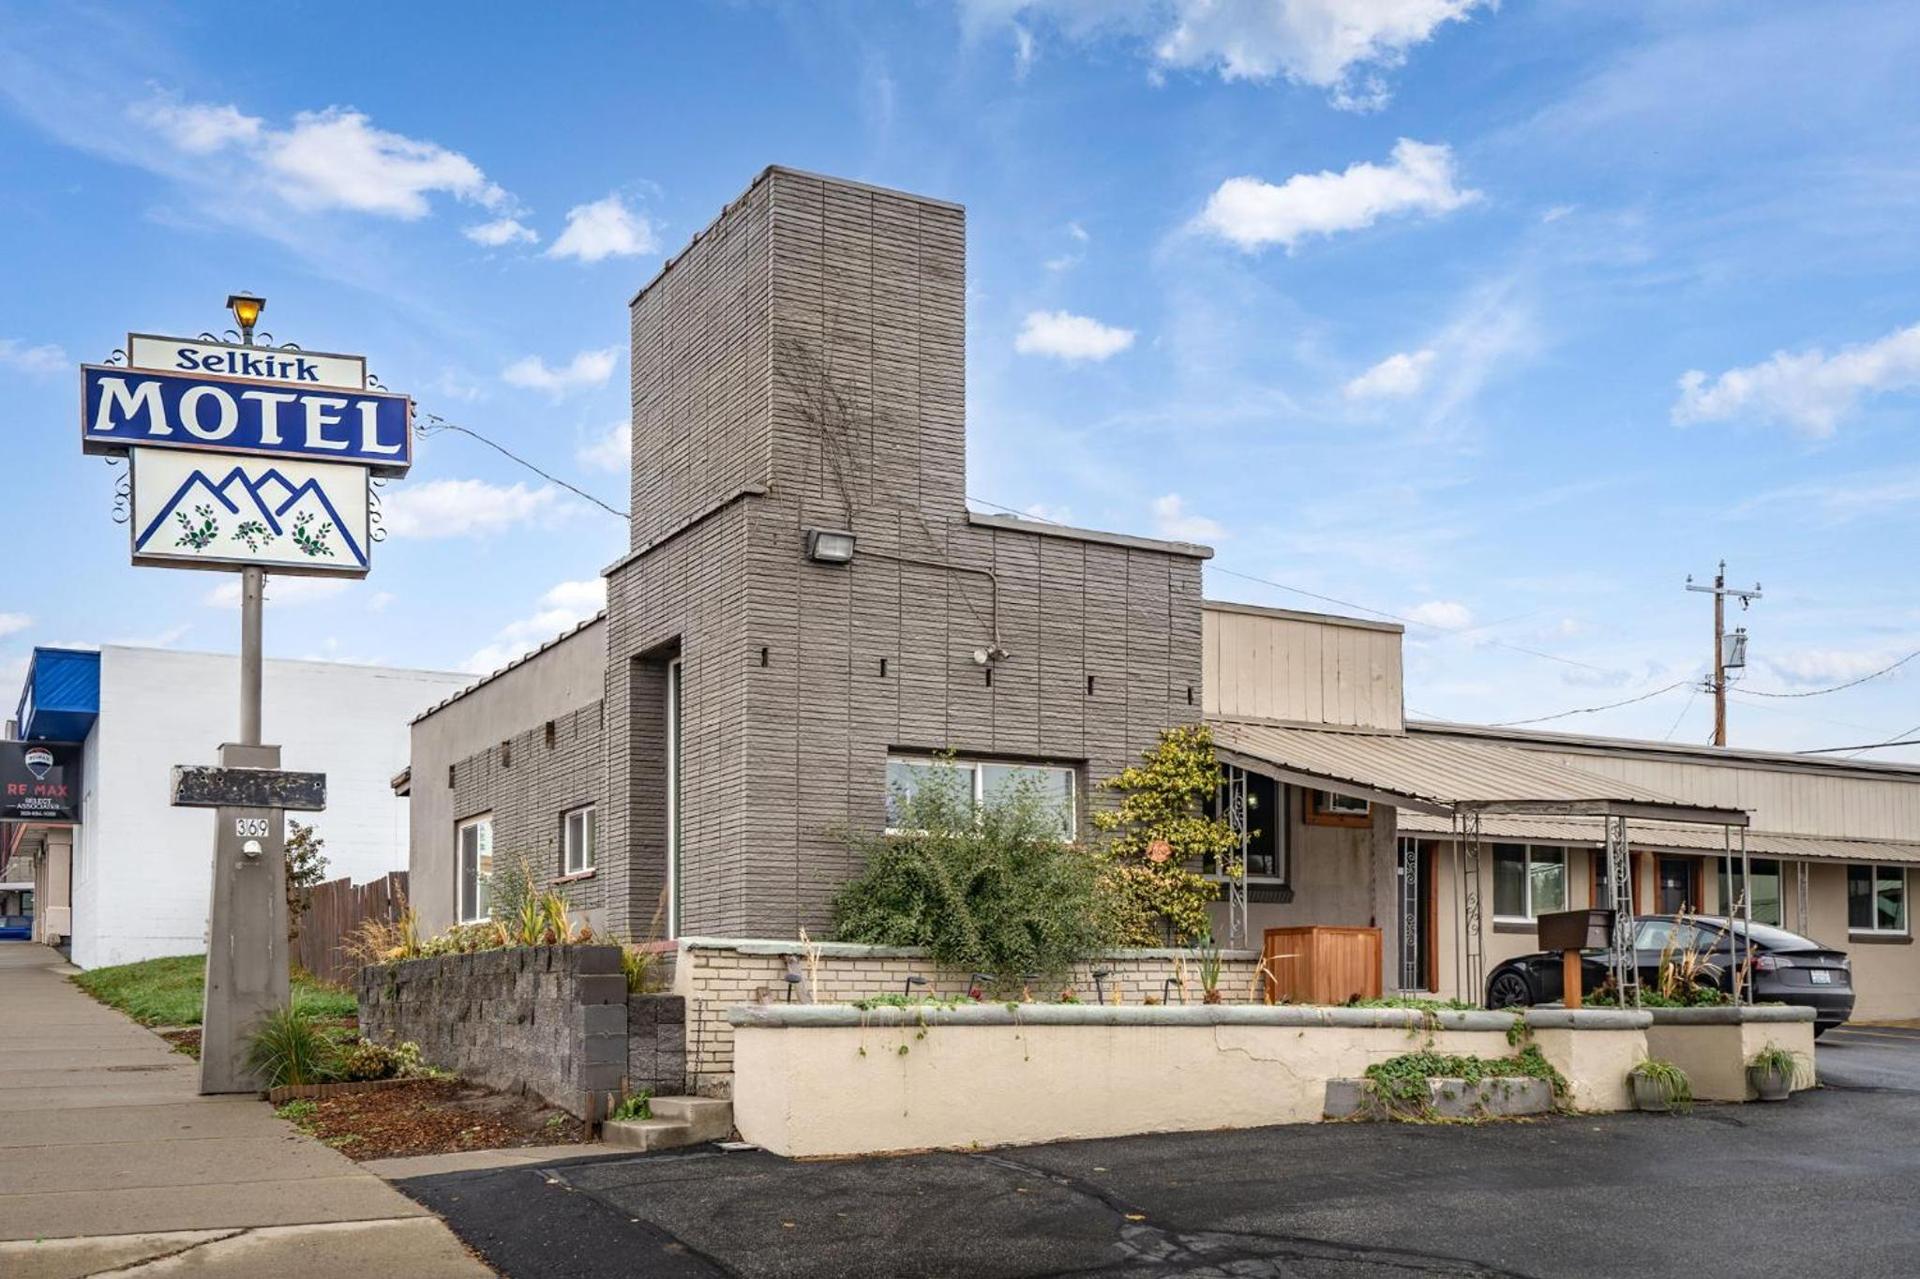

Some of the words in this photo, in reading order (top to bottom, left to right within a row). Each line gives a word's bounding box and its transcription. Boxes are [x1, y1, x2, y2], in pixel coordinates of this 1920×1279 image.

[176, 348, 319, 381] Selkirk
[94, 377, 402, 454] MOTEL
[237, 819, 268, 836] 369
